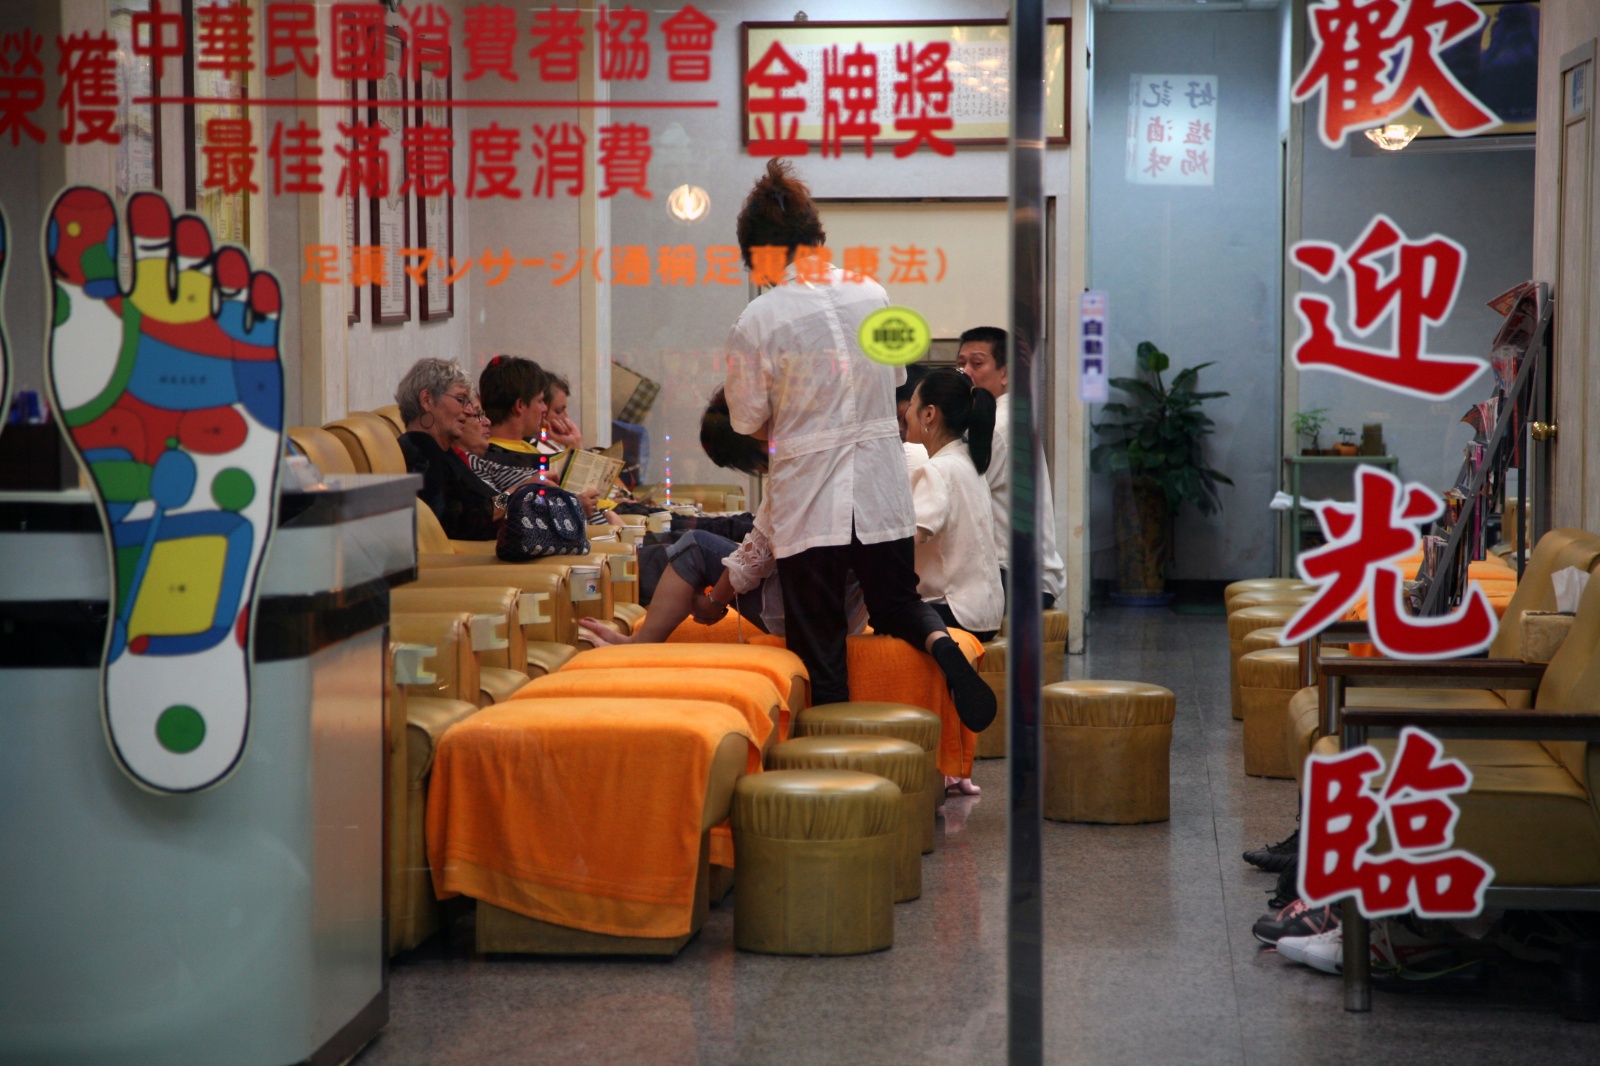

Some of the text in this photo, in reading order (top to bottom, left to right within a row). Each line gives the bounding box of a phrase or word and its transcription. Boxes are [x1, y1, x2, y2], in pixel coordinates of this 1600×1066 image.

[0, 28, 122, 146] 榮獲
[132, 0, 718, 83] 中華民國消費者協會
[202, 119, 654, 199] 最佳滿意度消費
[1278, 0, 1504, 918] 歡迎光臨
